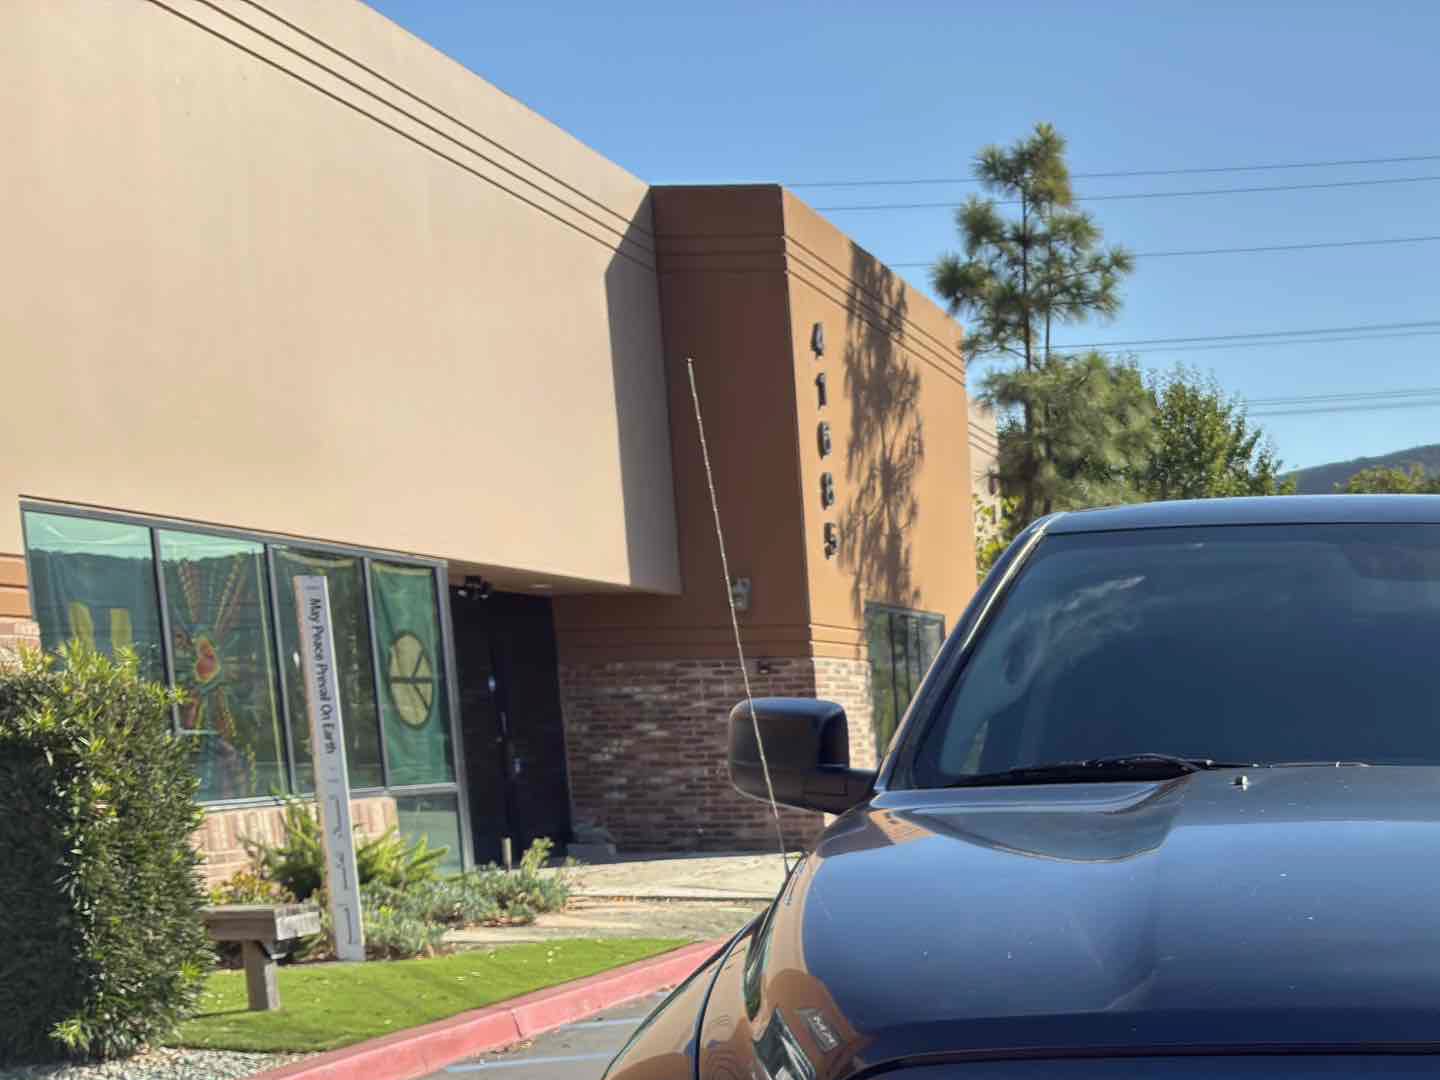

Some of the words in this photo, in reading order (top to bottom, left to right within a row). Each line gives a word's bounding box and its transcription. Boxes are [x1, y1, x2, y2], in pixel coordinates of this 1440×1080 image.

[810, 322, 838, 559] 41685
[307, 598, 321, 623] May
[311, 625, 325, 662] Peace
[317, 664, 329, 701] Prevail
[320, 703, 333, 721] On
[323, 723, 336, 754] Earth
